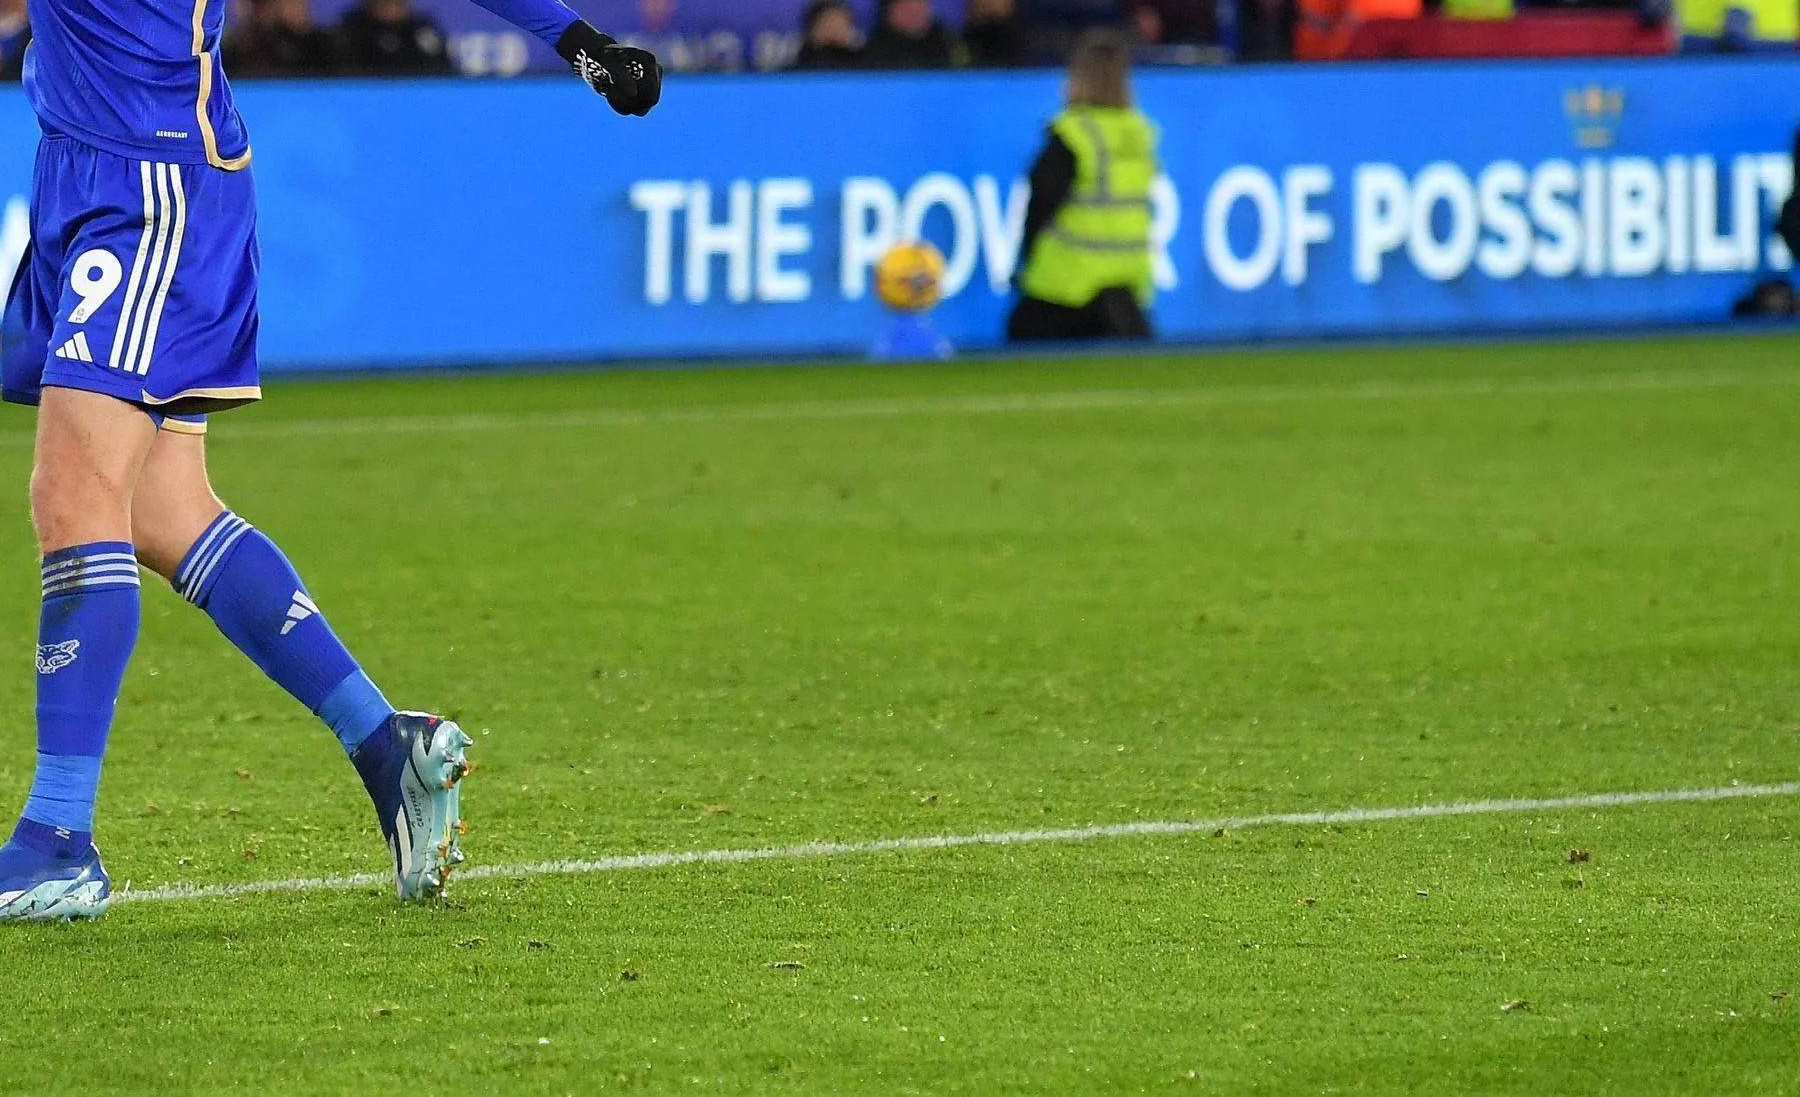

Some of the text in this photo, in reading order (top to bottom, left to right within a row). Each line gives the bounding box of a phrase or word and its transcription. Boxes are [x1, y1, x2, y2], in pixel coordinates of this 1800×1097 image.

[70, 248, 123, 323] 9
[630, 177, 813, 304] THE
[1204, 163, 1335, 292] OF
